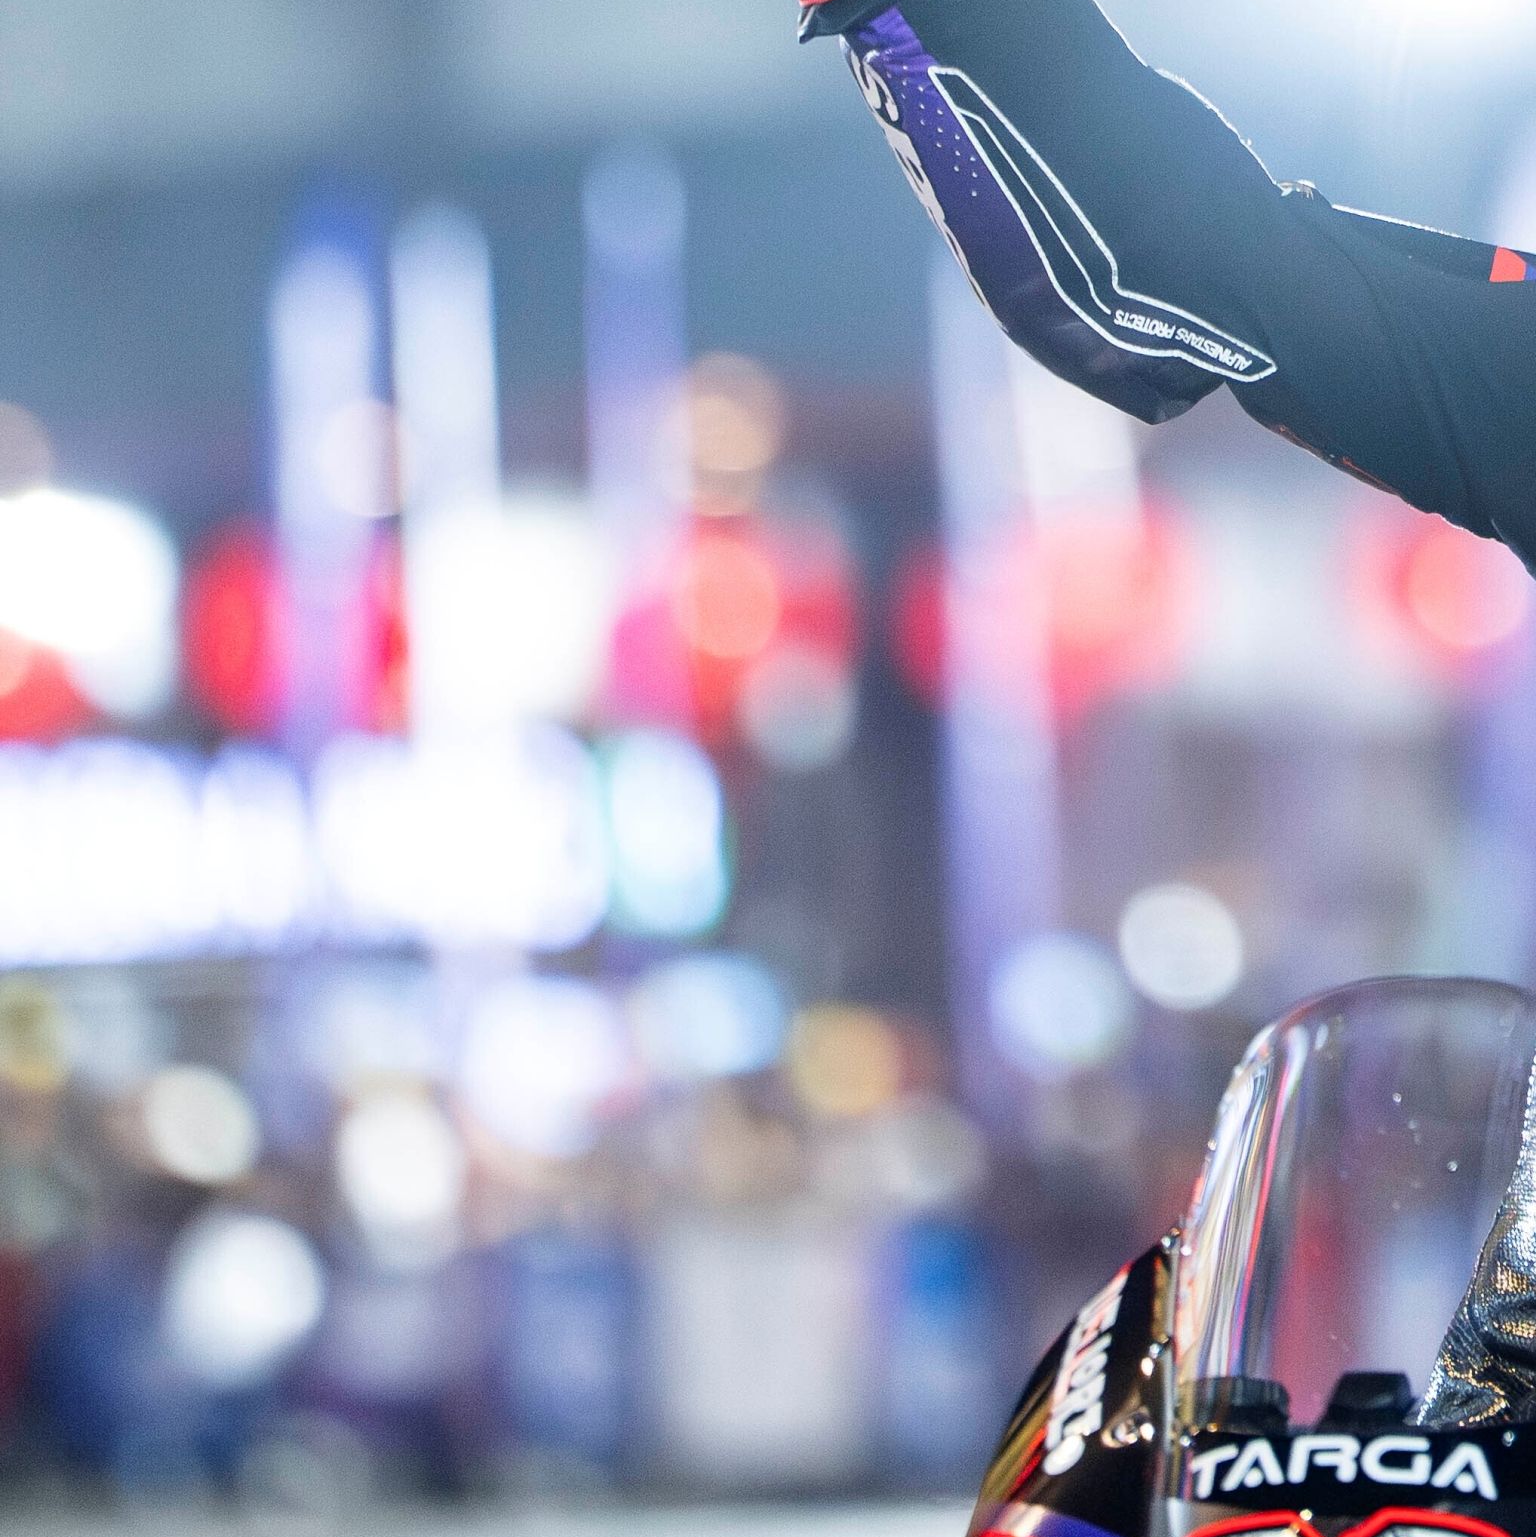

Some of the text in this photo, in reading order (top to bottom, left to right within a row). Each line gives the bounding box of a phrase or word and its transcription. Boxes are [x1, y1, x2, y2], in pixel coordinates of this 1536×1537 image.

[1113, 308, 1253, 372] ALPINESTARS PROTECTS
[1191, 1433, 1498, 1500] TARGA
